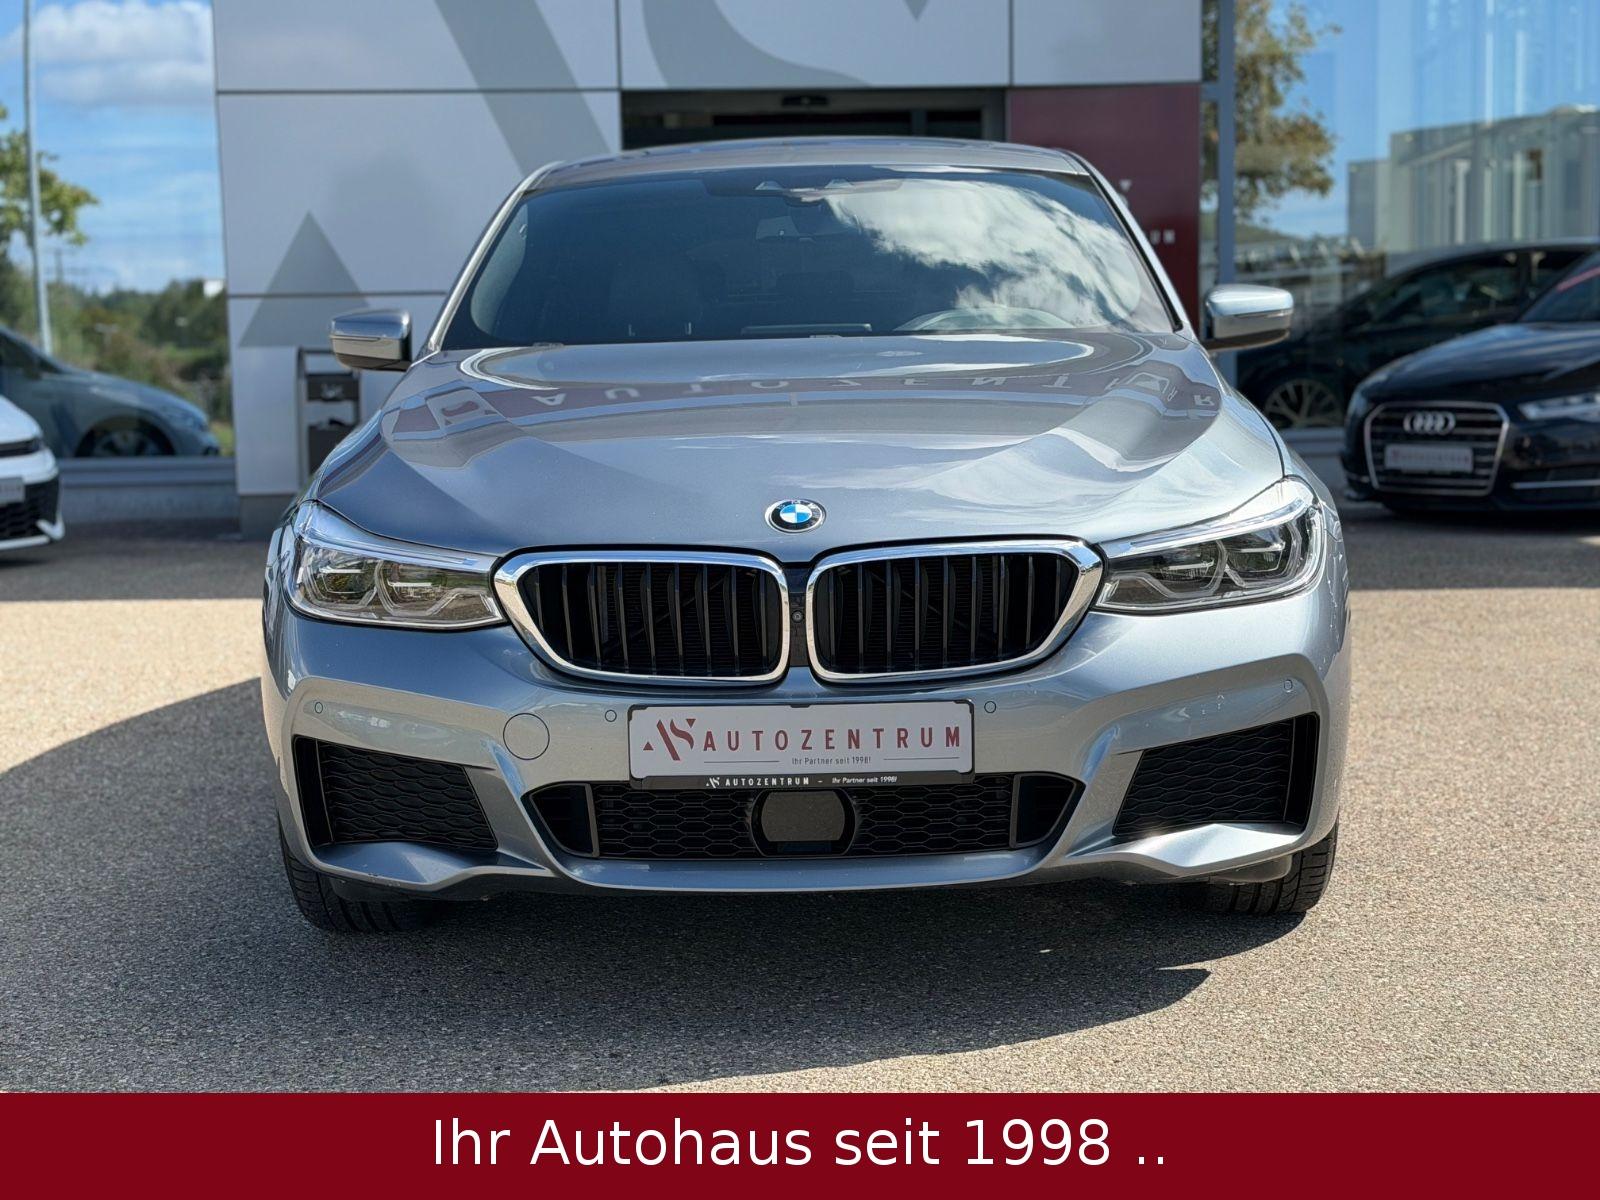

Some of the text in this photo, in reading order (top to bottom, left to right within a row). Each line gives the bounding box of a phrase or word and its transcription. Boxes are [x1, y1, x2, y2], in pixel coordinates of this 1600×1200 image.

[703, 726, 960, 752] AUTOZENTRUM
[792, 756, 872, 765] Ihr Partner seit 1998!
[725, 777, 809, 787] AUTOZENTRUM
